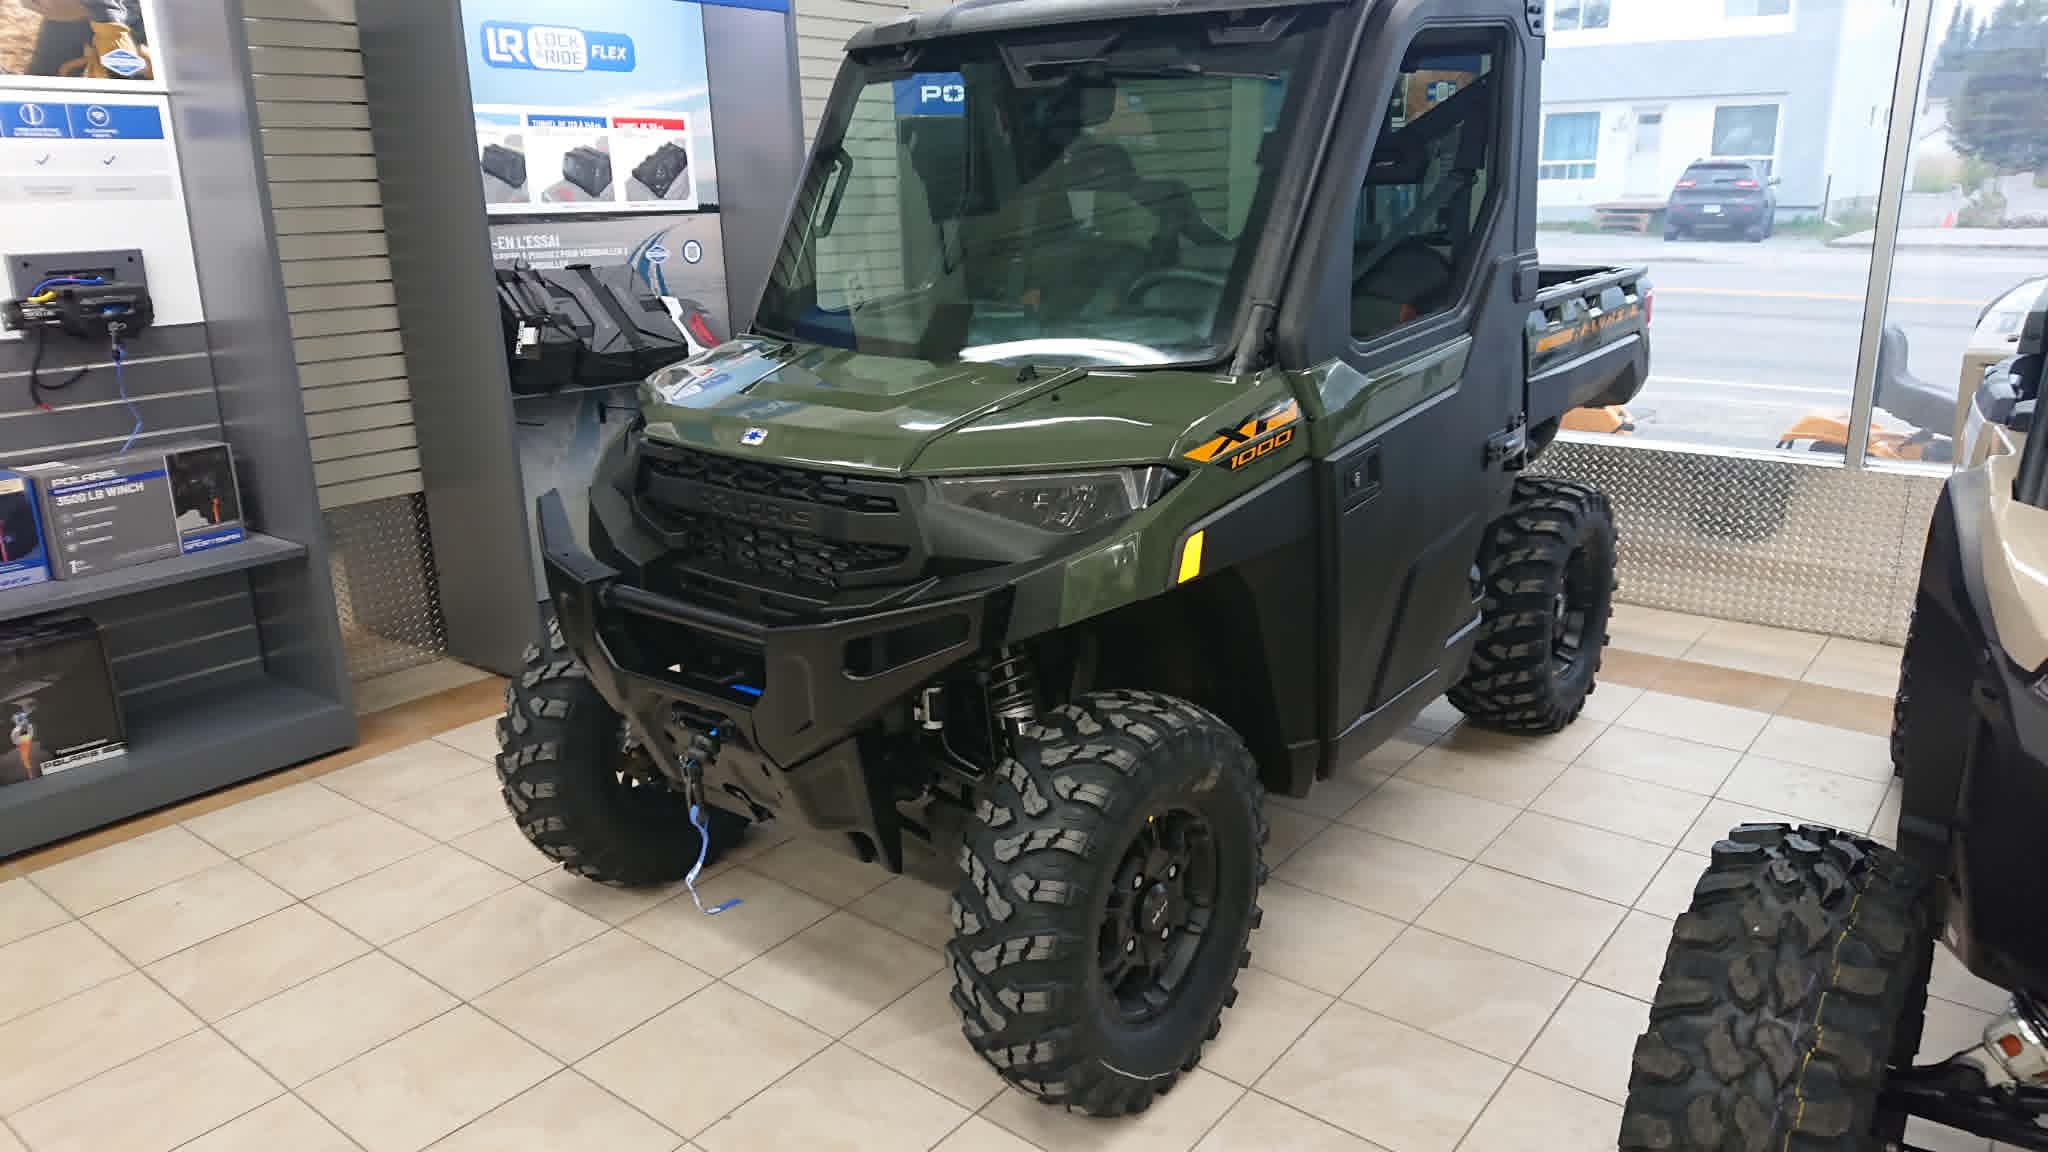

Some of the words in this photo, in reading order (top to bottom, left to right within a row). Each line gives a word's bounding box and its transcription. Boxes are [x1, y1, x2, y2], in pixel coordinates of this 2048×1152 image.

[534, 31, 579, 48] LOCK
[544, 50, 584, 65] RIDE
[591, 44, 628, 61] FLEX
[519, 233, 560, 249] L'ESSAI
[1231, 429, 1293, 470] 1000
[51, 469, 119, 488] POLARIS
[88, 489, 104, 501] LB
[105, 481, 144, 497] WINCH
[44, 750, 99, 769] POLARIS
